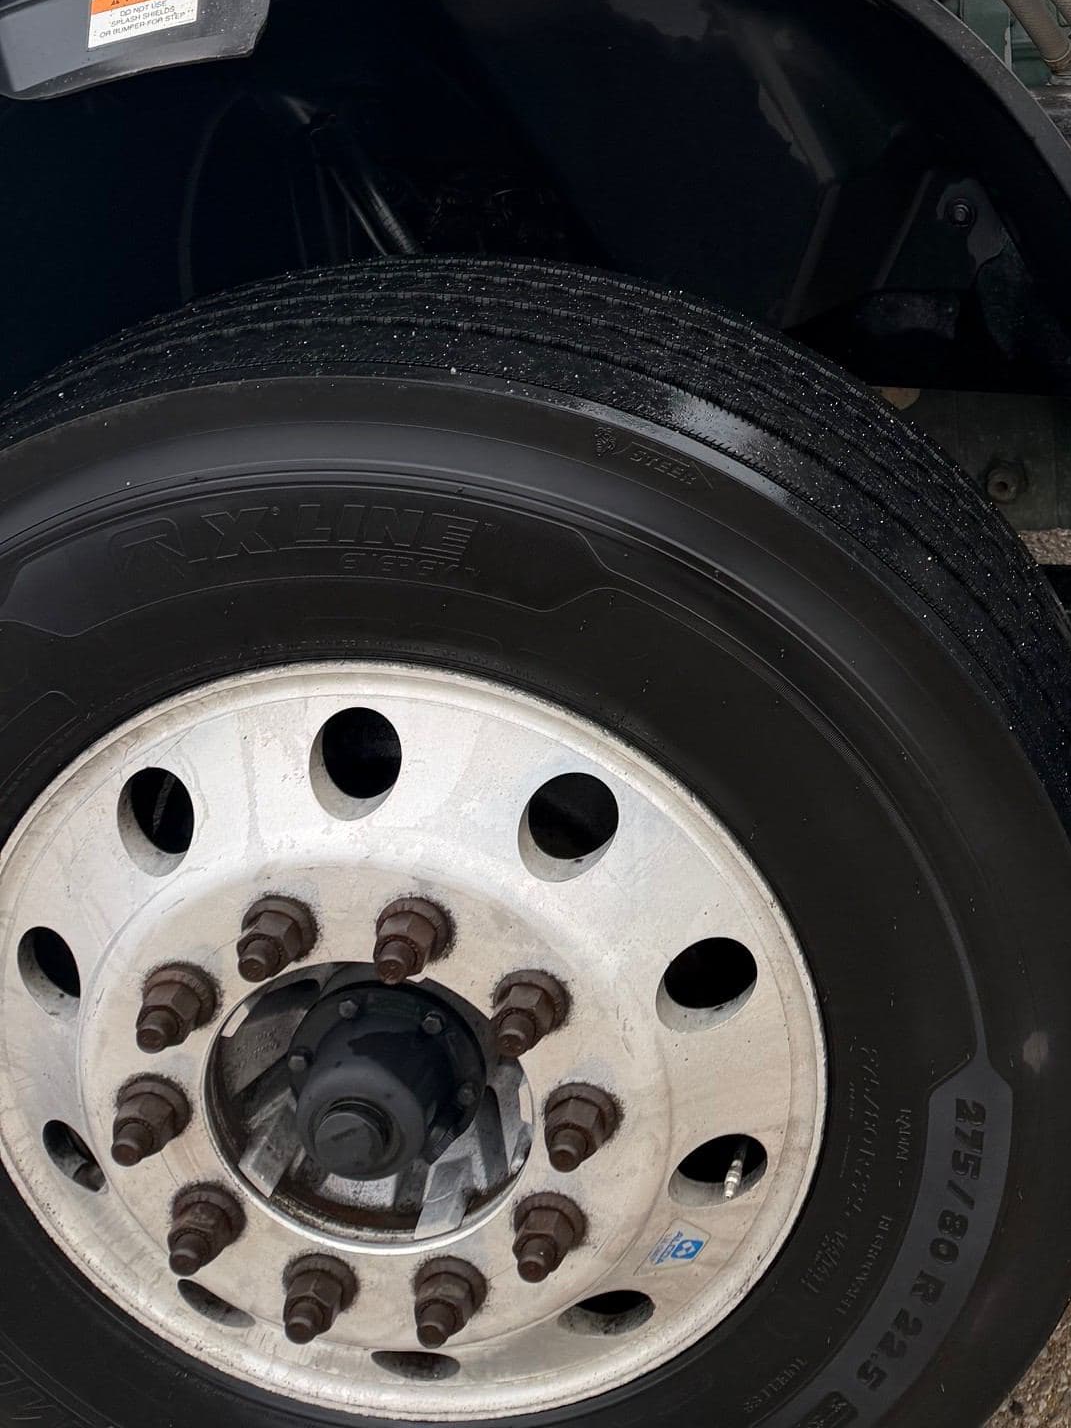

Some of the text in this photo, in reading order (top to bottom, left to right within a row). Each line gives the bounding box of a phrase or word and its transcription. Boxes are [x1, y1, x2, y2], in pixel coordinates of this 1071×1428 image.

[111, 5, 175, 27] SPLASH SHIELDS
[133, 5, 148, 13] NOT
[151, 0, 167, 8] USE
[99, 30, 111, 38] OR
[113, 21, 144, 35] BUMPER
[147, 17, 163, 26] FOR
[165, 11, 186, 21] STEP
[628, 450, 697, 485] STEER
[294, 503, 480, 563] LINE
[856, 1098, 987, 1391] 275/80 R 22.5
